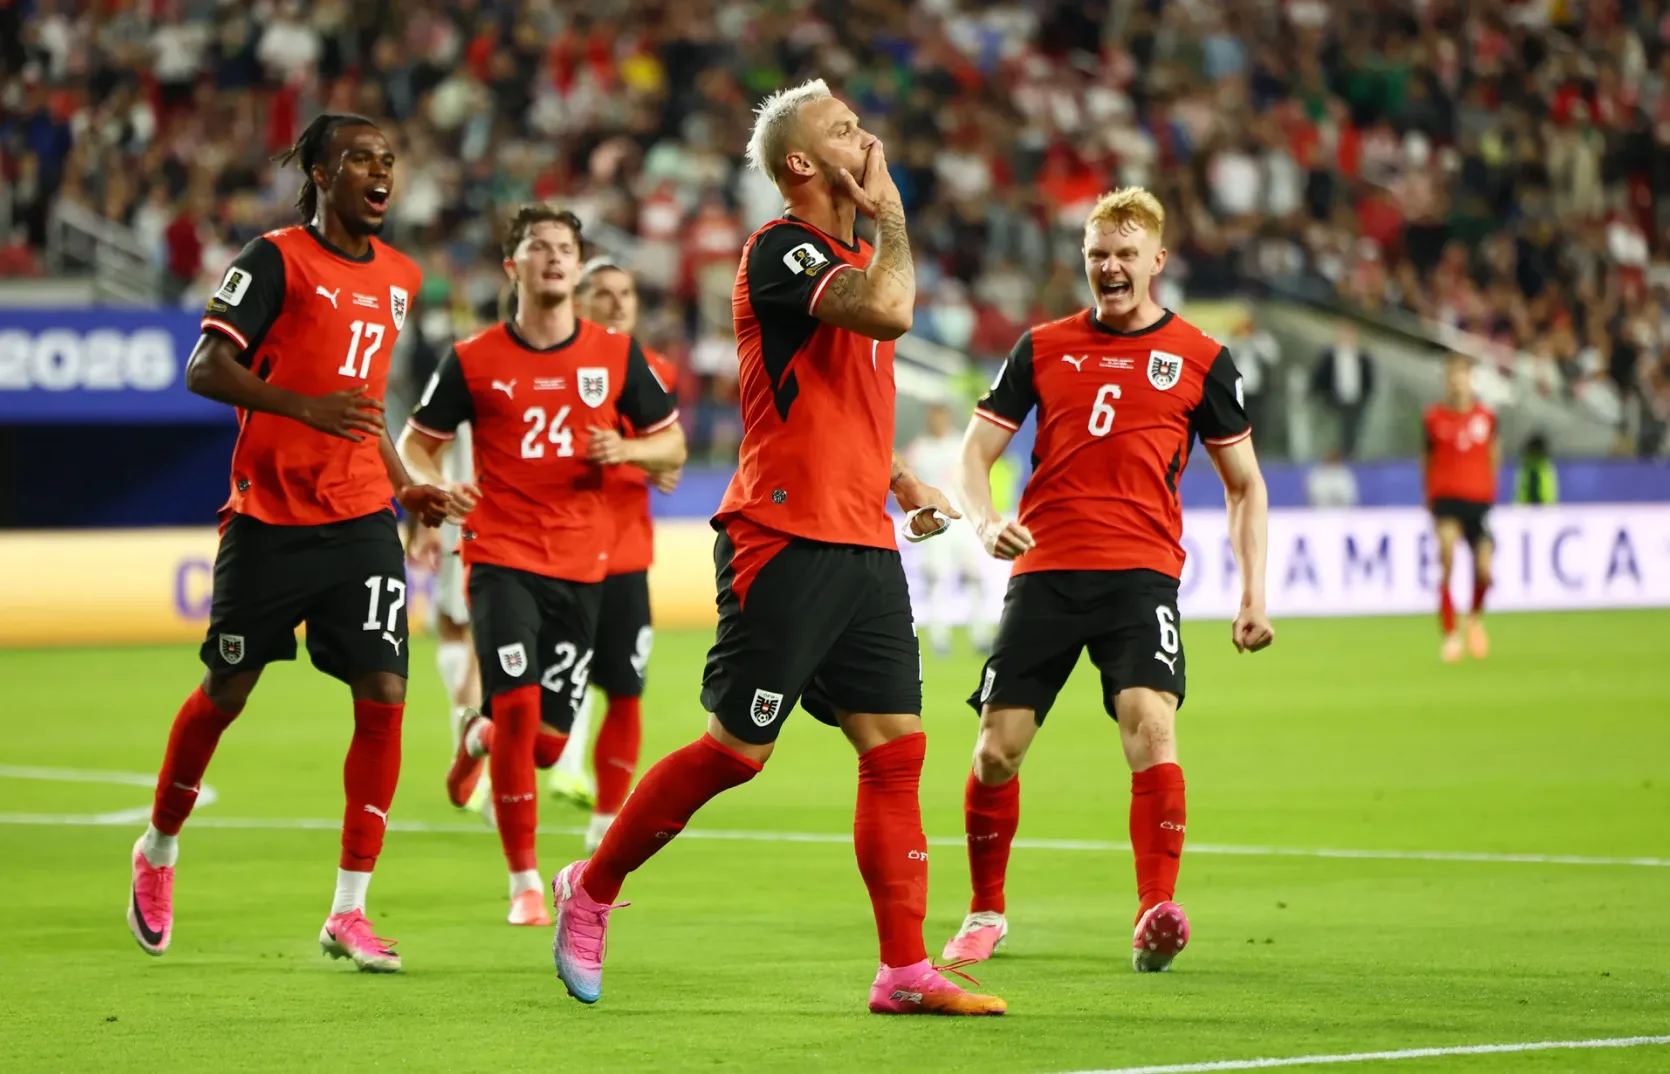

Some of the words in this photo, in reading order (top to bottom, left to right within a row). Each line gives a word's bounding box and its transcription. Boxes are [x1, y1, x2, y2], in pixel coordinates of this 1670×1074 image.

[0, 328, 177, 391] 2026
[338, 320, 385, 379] 17
[521, 406, 573, 459] 24
[1088, 384, 1121, 437] 6
[1283, 527, 1642, 594] AMEICA
[362, 575, 406, 632] 17
[1155, 604, 1179, 654] 6
[541, 640, 594, 699] 24
[1160, 820, 1185, 833] ÖF
[908, 849, 928, 861] ÖF
